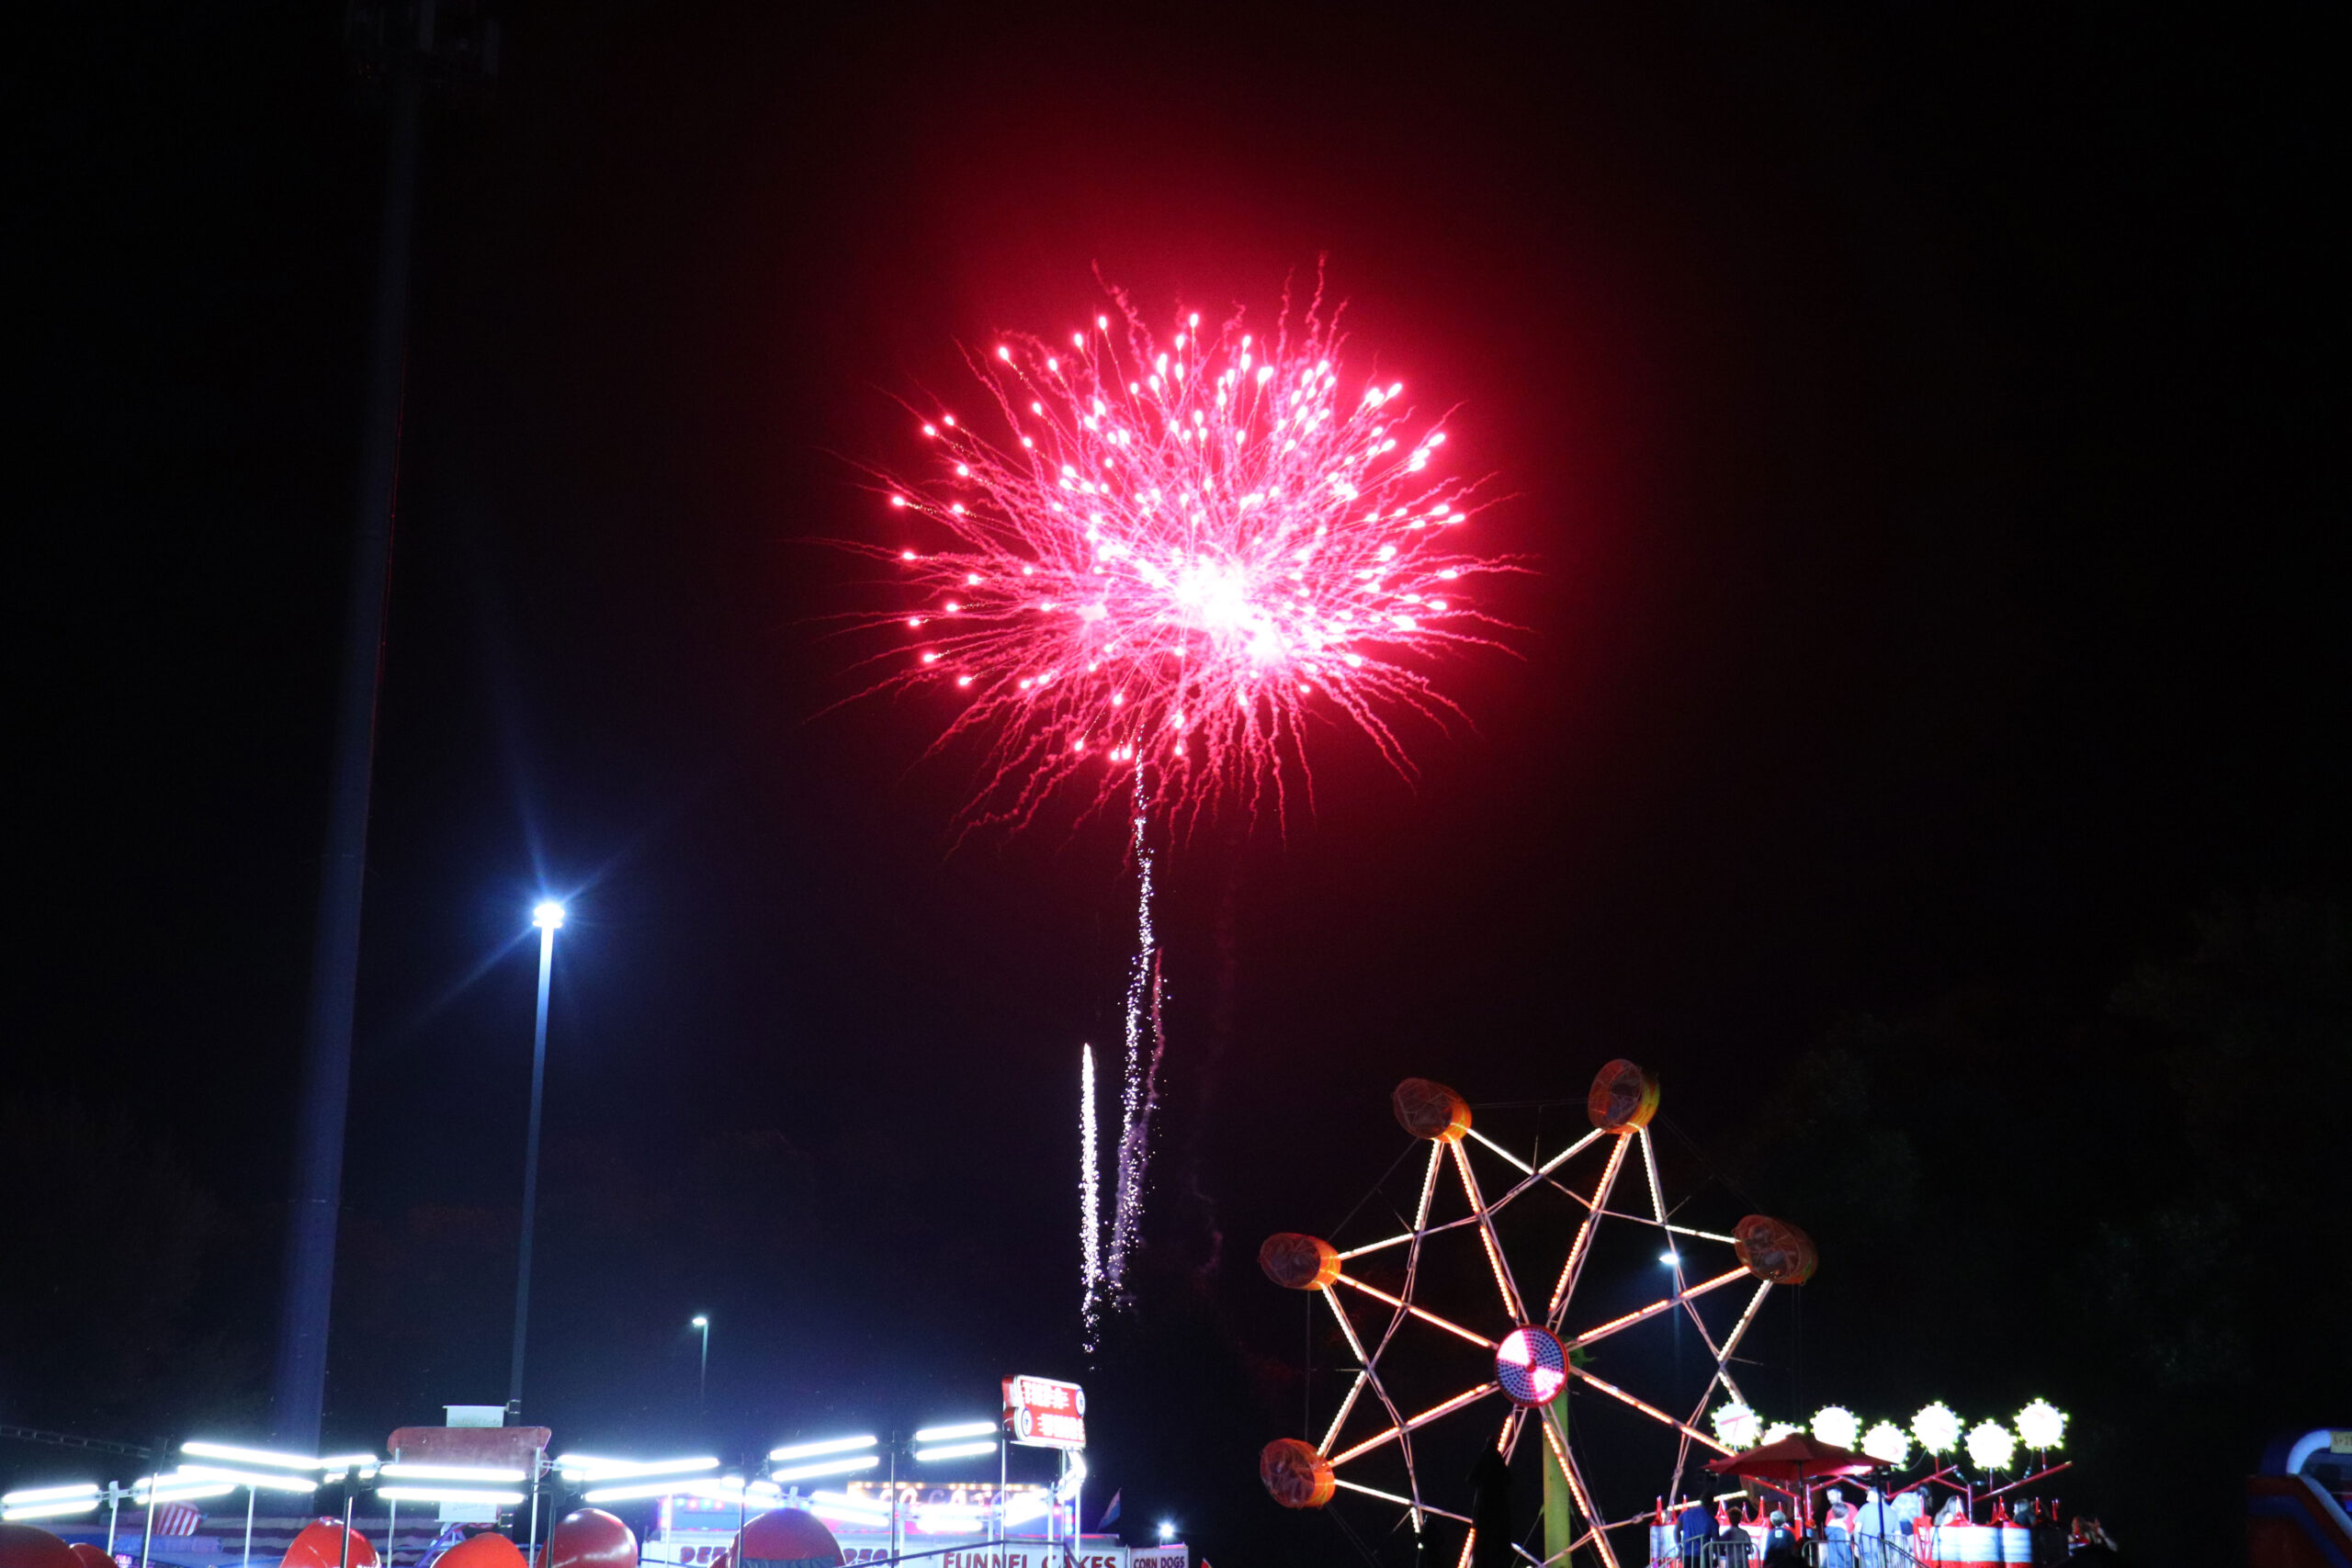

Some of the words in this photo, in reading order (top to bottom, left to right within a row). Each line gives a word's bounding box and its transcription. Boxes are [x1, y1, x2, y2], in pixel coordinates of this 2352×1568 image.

[944, 1552, 1028, 1568] FUNNEL
[1133, 1556, 1158, 1568] CORN
[1159, 1555, 1185, 1568] DOGS
